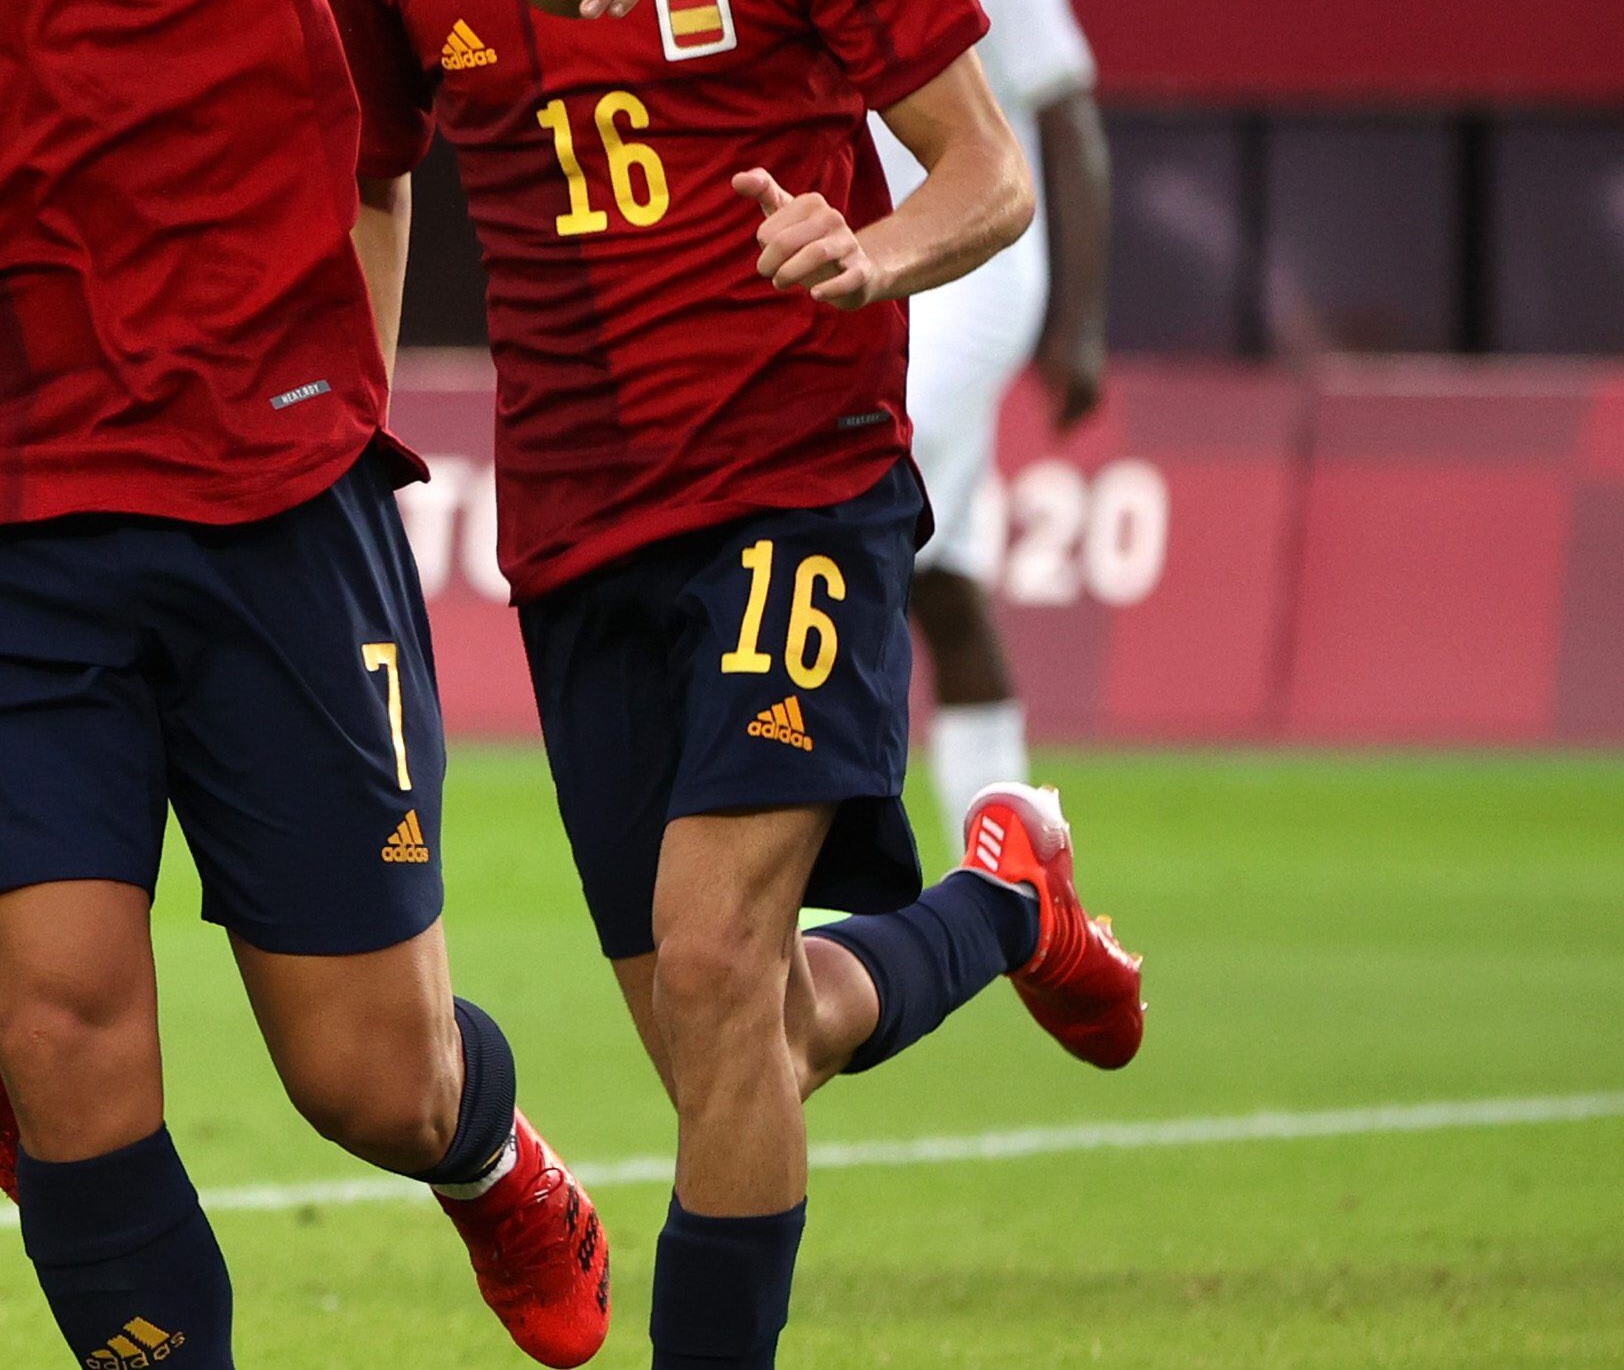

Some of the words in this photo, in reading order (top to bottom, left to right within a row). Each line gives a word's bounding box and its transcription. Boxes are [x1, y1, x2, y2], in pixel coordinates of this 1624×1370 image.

[441, 47, 498, 70] adidas
[536, 90, 670, 236] 16
[720, 539, 847, 690] 16
[361, 643, 413, 791] 7
[747, 719, 813, 752] adidas
[381, 844, 430, 863] adidas
[86, 1331, 187, 1370] adidas
